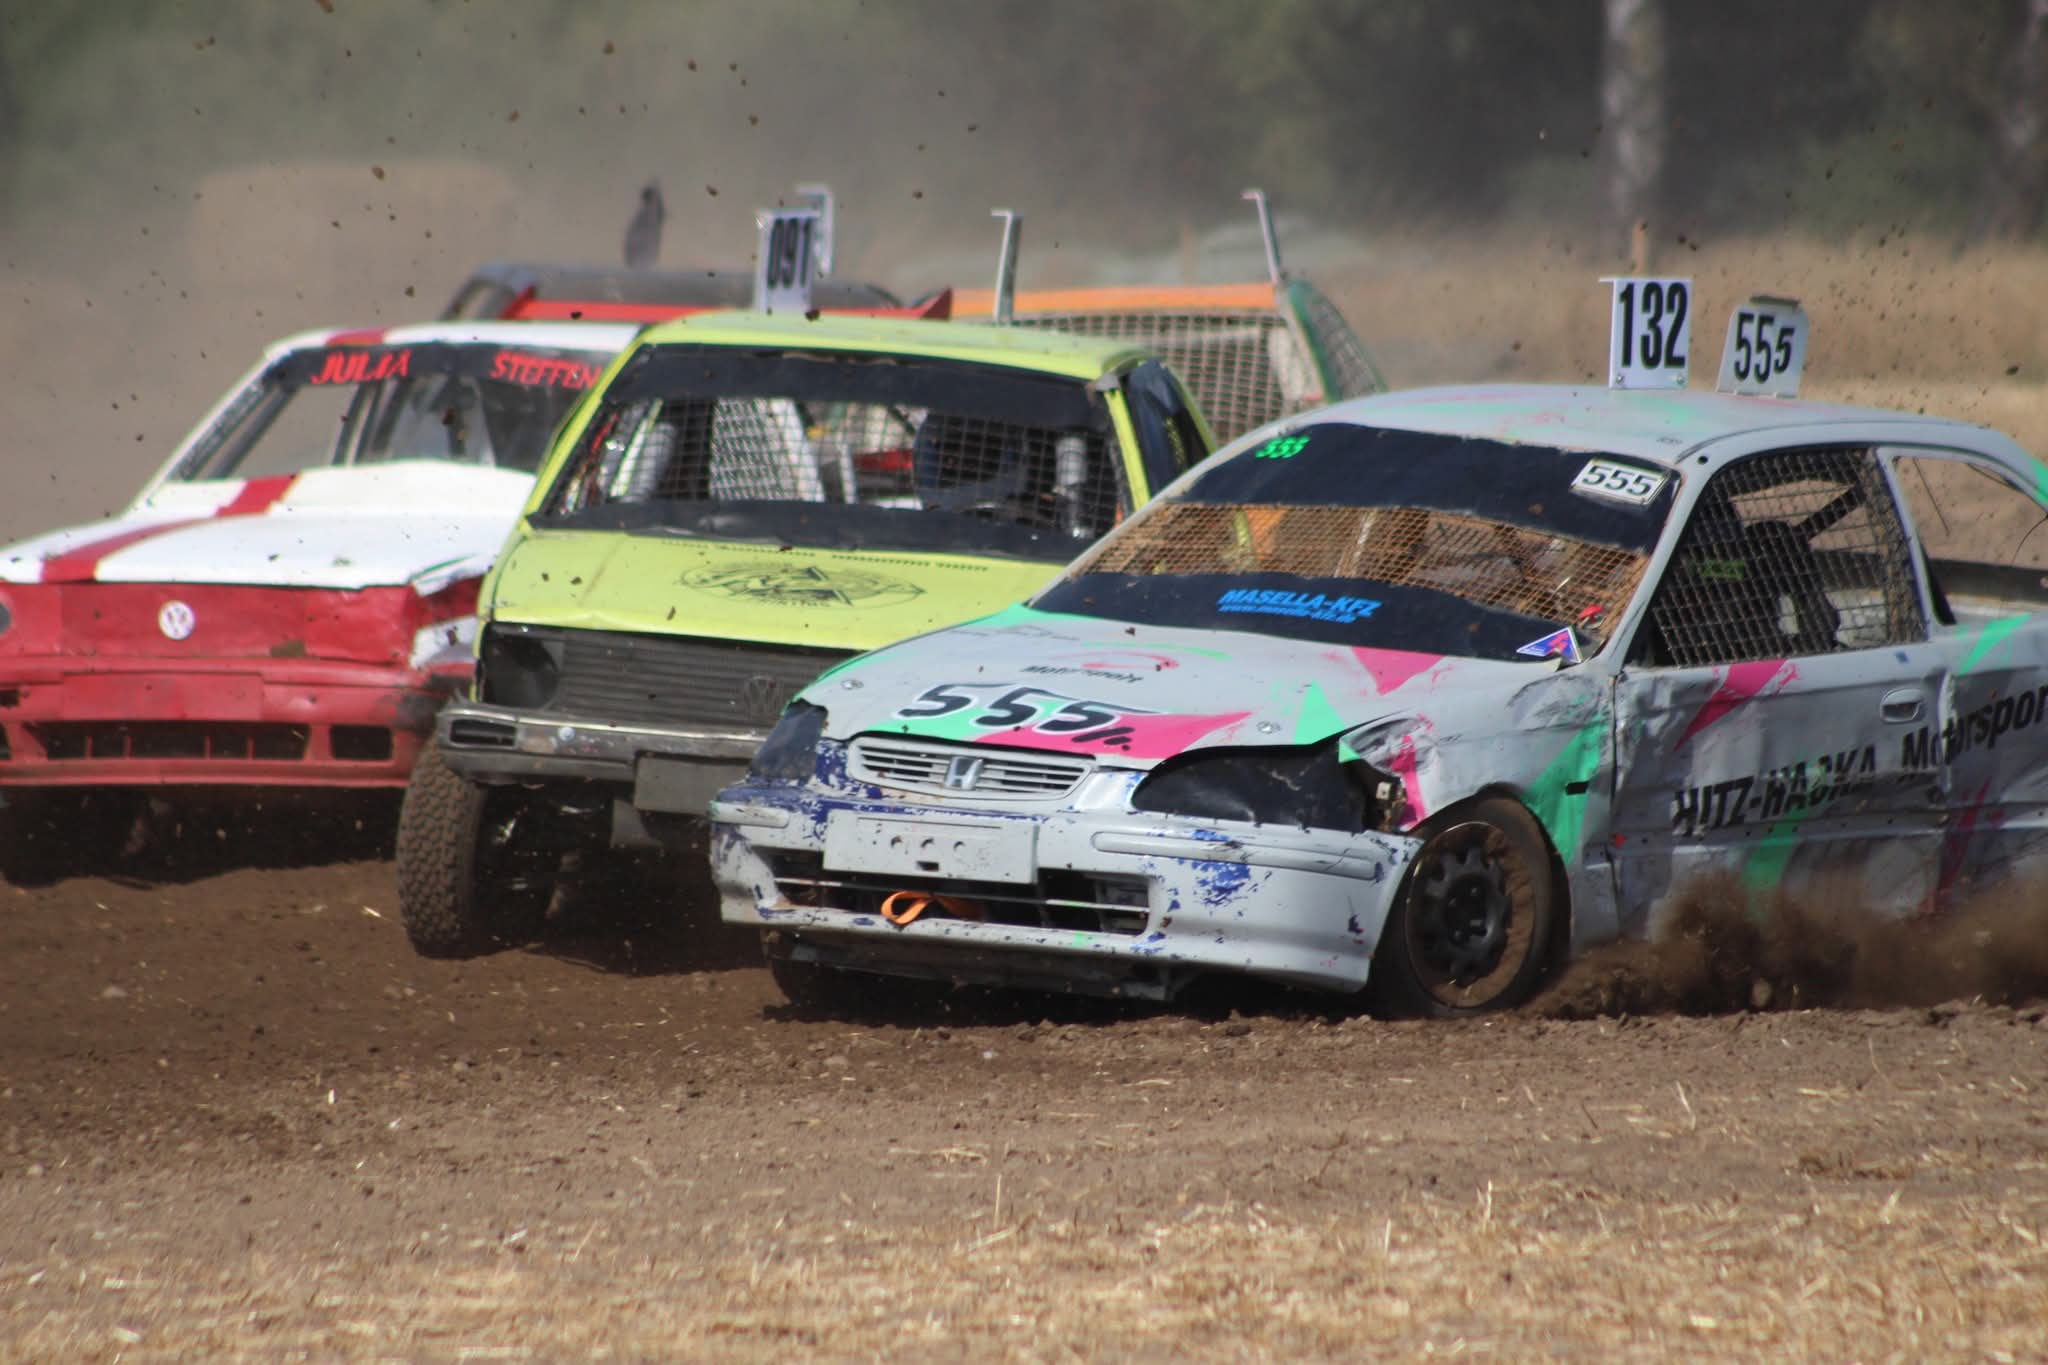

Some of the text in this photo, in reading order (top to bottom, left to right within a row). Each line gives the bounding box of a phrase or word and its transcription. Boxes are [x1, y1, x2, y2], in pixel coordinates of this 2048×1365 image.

[1619, 281, 1689, 369] 132
[1733, 312, 1795, 384] 555
[310, 350, 412, 385] JULIA
[489, 352, 602, 390] STEFFEN
[1256, 435, 1310, 459] 555
[1582, 464, 1659, 497] 555
[1217, 588, 1383, 618] MASELLA-KFZ
[895, 683, 1166, 732] 555
